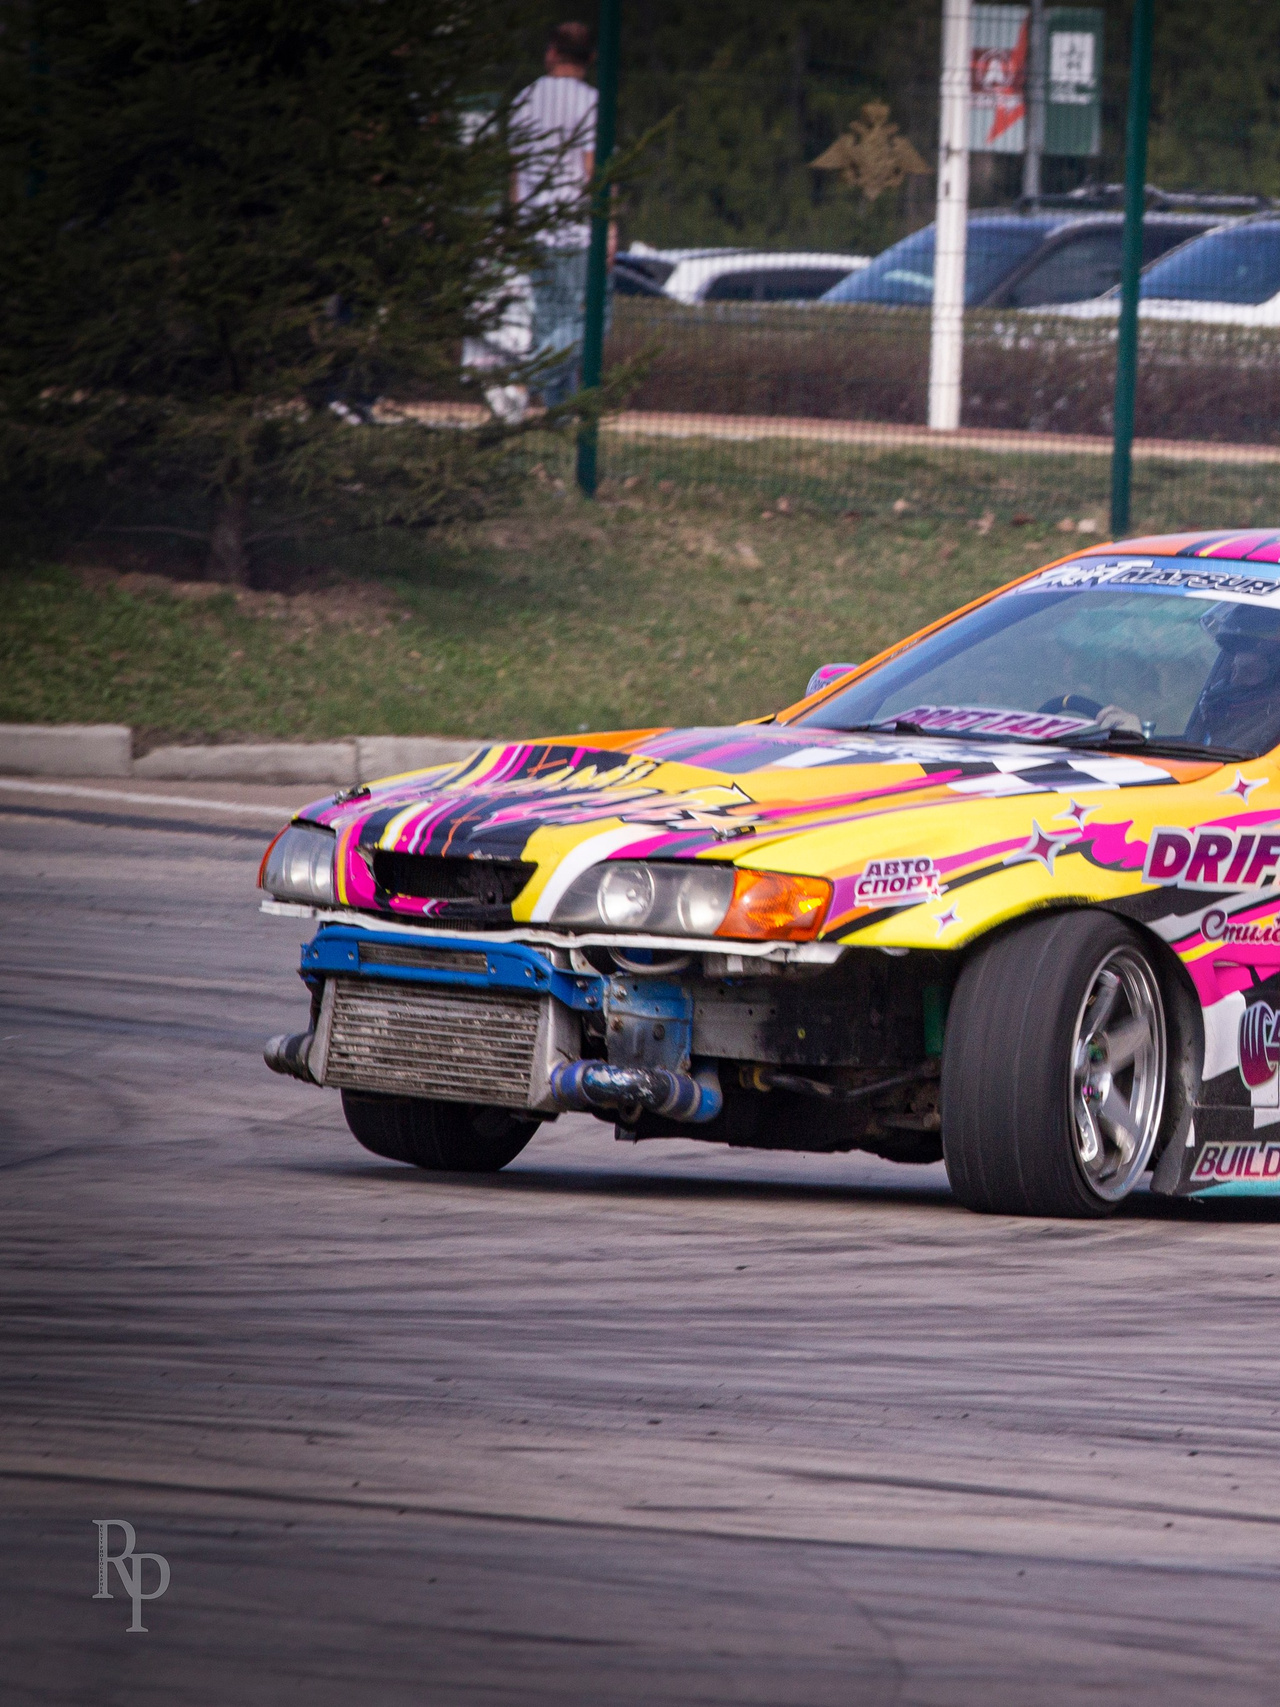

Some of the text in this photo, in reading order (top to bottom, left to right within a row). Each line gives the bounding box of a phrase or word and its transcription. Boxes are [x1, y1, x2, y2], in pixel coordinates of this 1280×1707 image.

[980, 714, 1086, 739] TAXI
[866, 859, 931, 877] АВТО
[857, 873, 937, 896] СПОРТ
